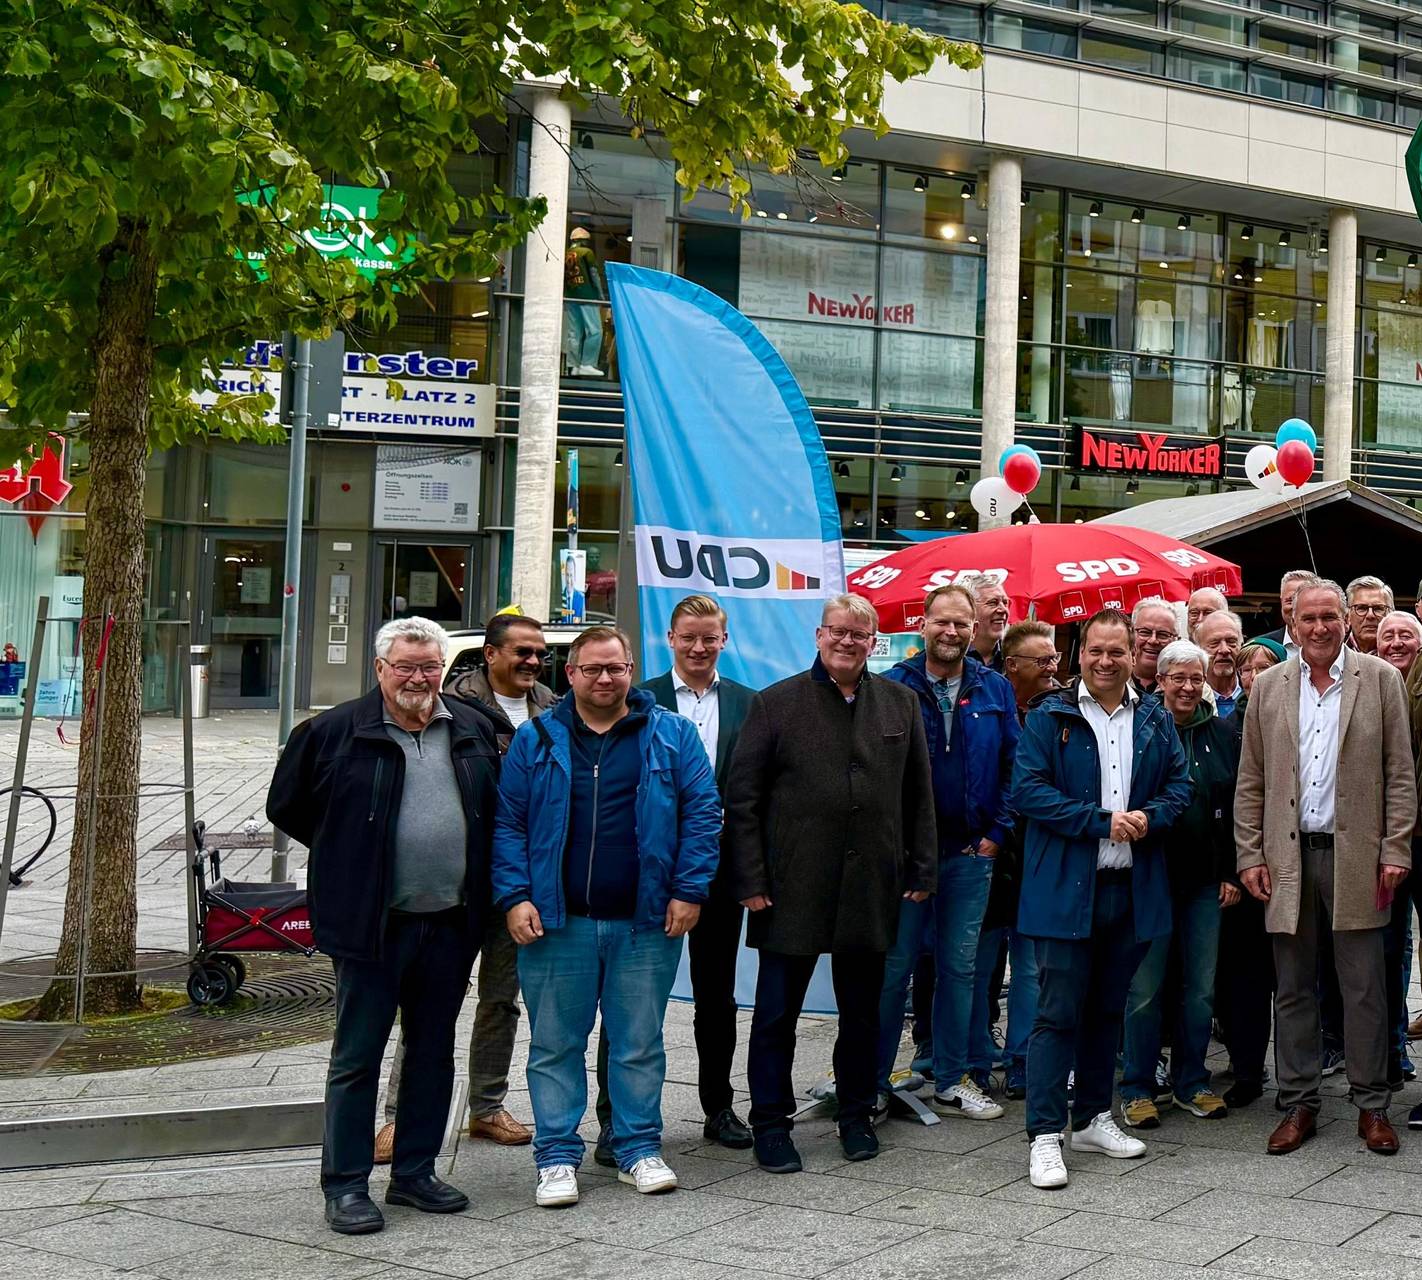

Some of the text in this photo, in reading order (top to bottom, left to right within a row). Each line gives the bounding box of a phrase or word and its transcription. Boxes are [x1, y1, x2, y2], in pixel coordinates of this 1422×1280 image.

[464, 393, 476, 404] 2
[989, 498, 997, 517] CDU
[339, 563, 344, 571] 2
[1055, 557, 1140, 583] SPD
[851, 565, 902, 589] SPD
[1063, 605, 1083, 617] SPD
[1104, 600, 1122, 610] SPD
